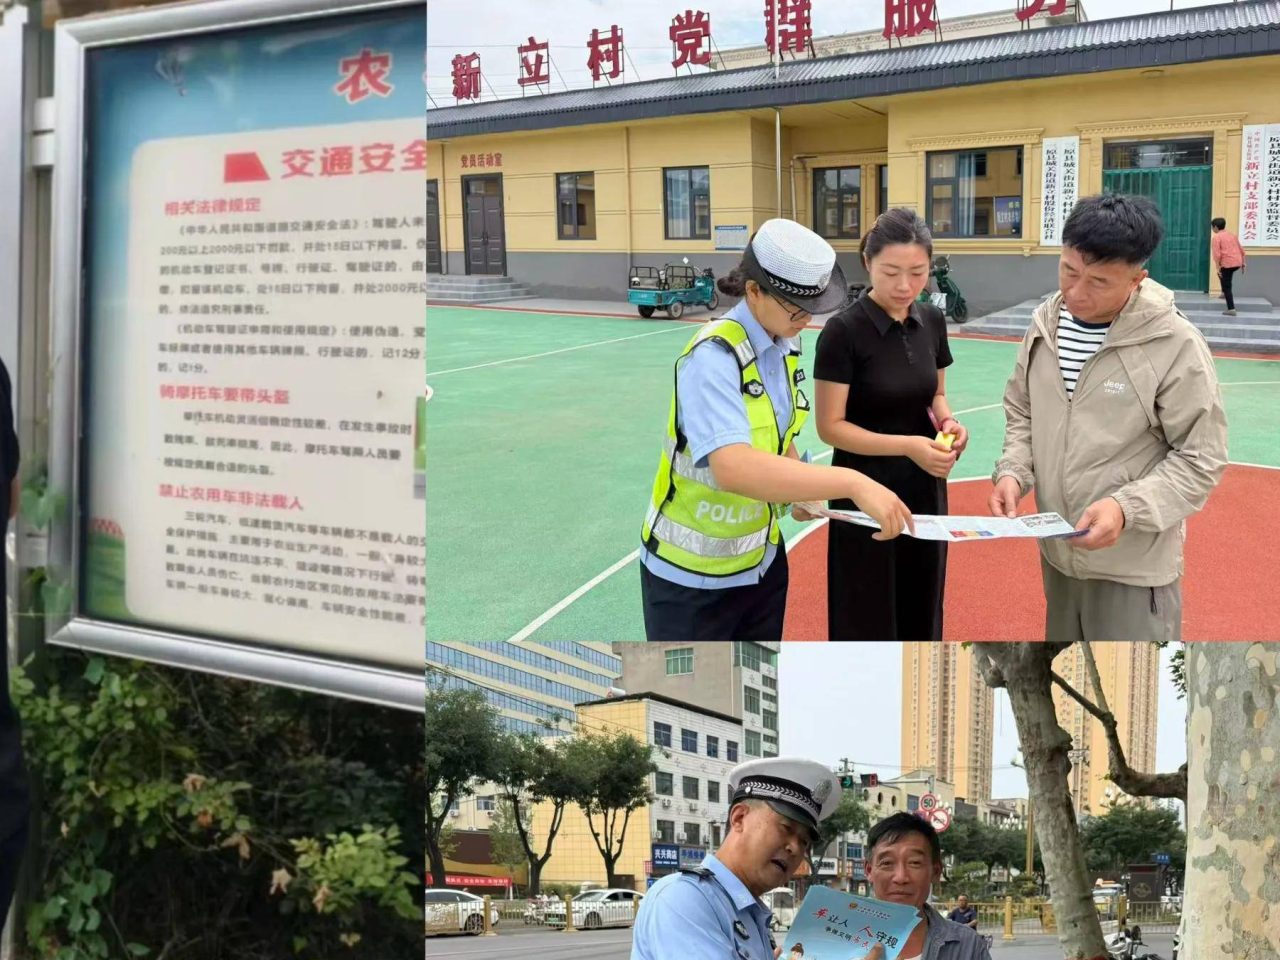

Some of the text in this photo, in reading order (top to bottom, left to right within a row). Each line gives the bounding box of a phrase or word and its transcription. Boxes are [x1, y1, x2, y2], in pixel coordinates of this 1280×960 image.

[280, 139, 426, 179] 交通安全
[460, 152, 503, 168] 党员活动室
[164, 197, 261, 216] 相关法律规定
